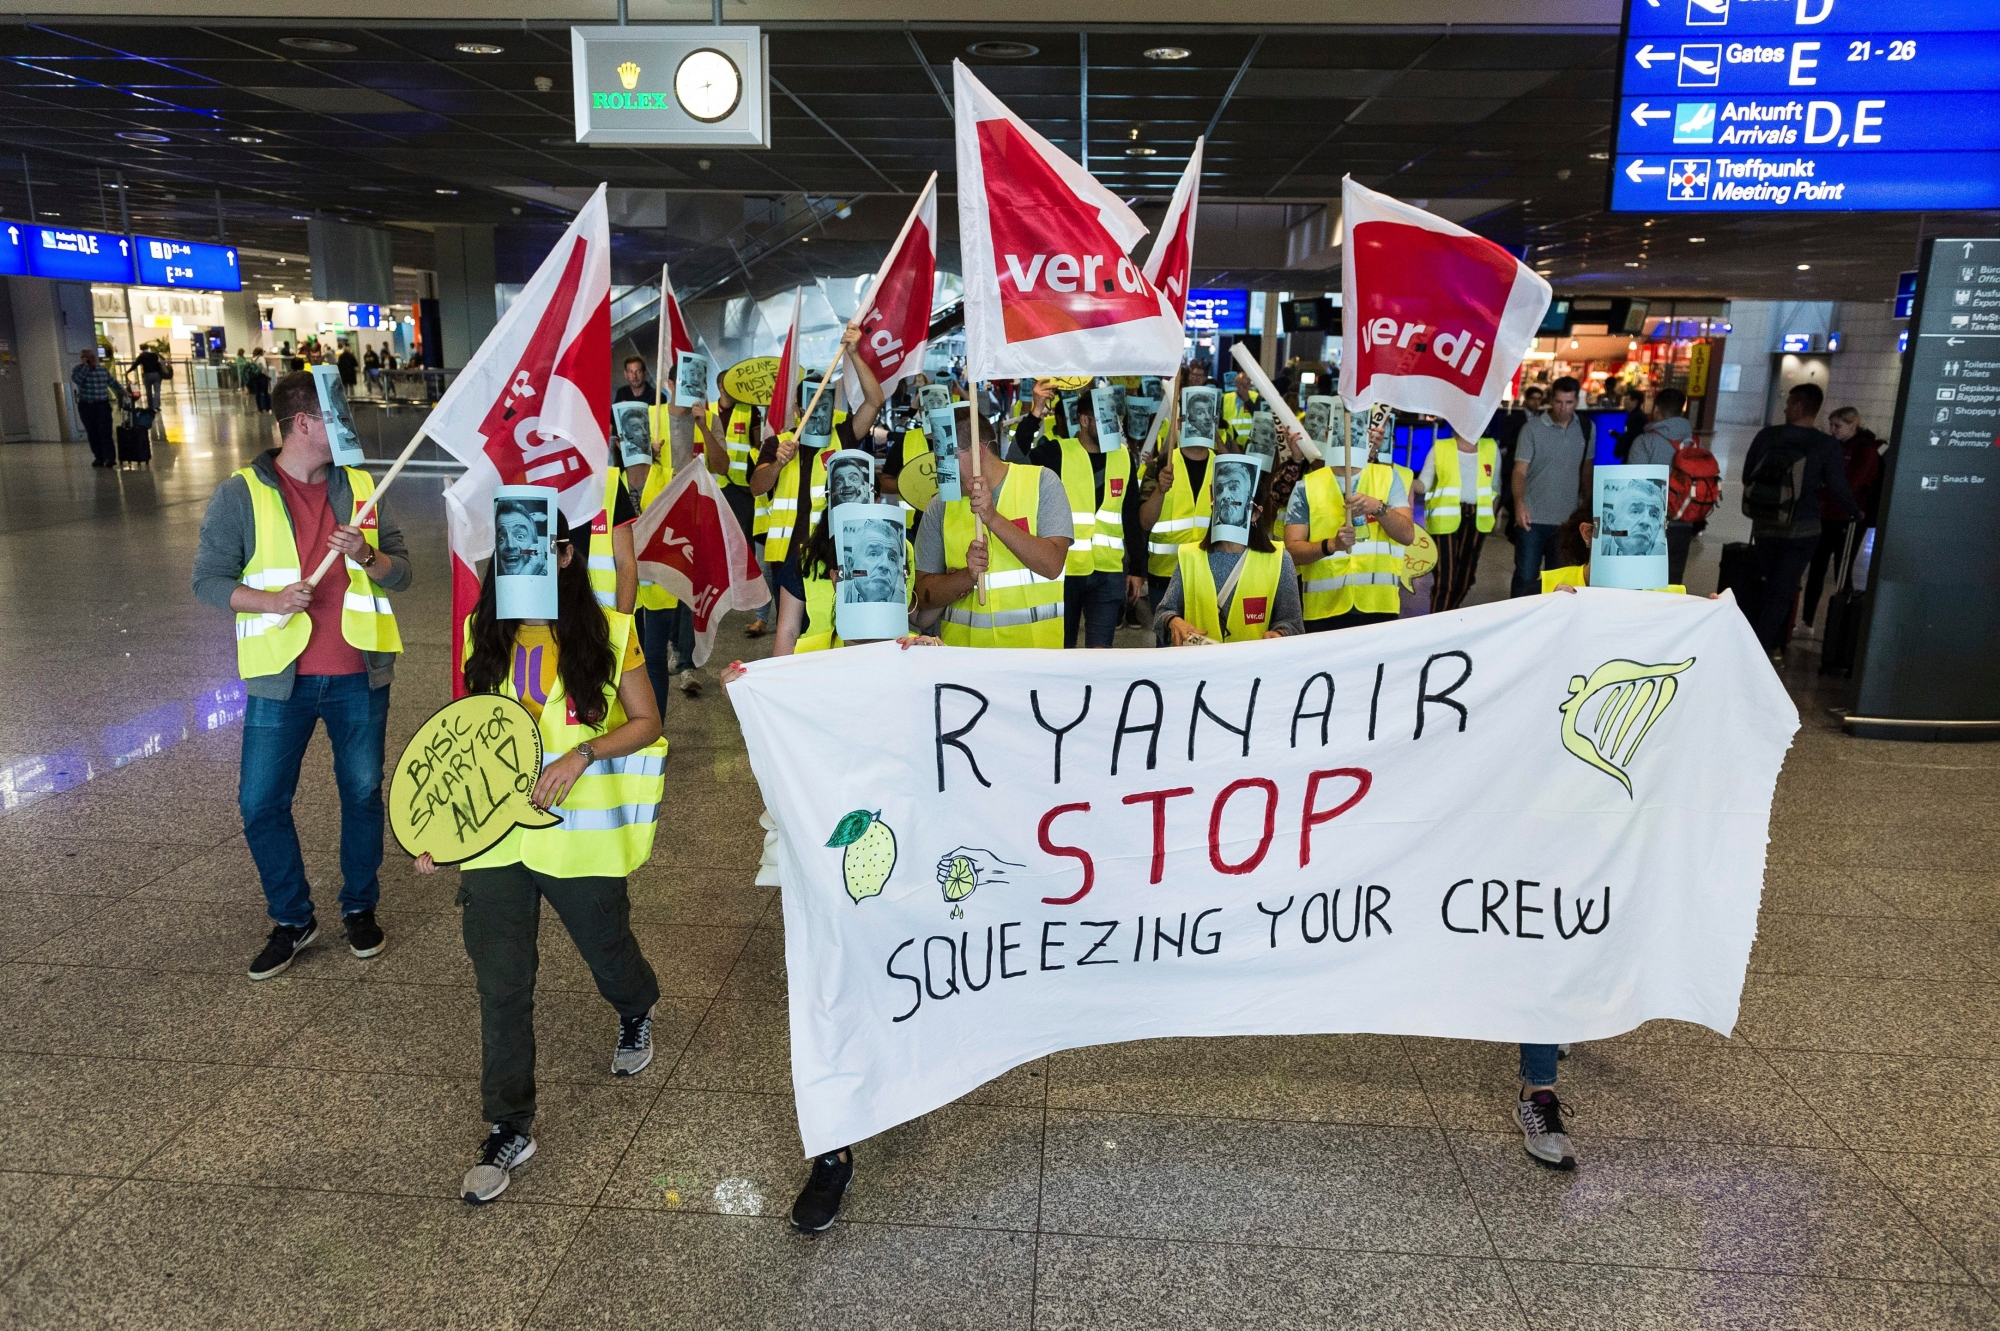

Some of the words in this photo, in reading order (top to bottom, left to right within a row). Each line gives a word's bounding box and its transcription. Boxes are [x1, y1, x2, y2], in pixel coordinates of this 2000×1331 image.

[1726, 43, 1785, 64] Gates
[1788, 42, 1821, 86] E
[1847, 41, 1871, 61] 21
[1887, 40, 1917, 61] 26
[592, 92, 668, 109] ROLEX
[1720, 101, 1803, 121] Ankunft
[1804, 100, 1886, 147] D,E
[1718, 125, 1797, 145] Arrivals
[1715, 158, 1815, 181] Treffpunkt
[1712, 182, 1791, 204] Meeting
[1793, 181, 1845, 200] Point
[1362, 317, 1486, 377] ver.di
[736, 361, 778, 379] DELAYS
[1962, 369, 1990, 378] Toilets
[735, 374, 767, 394] MUST
[1956, 392, 1995, 403] Baggage
[1370, 402, 1390, 428] ver
[1955, 406, 1996, 417] Shopping
[1948, 439, 1992, 448] Pharmacy
[1950, 430, 1992, 439] Apotheke
[1942, 475, 1969, 483] Snack
[1971, 476, 1985, 484] Bar
[363, 518, 376, 526] r.di
[935, 650, 1473, 792] RYANAIR
[411, 738, 478, 839] SALARY
[475, 706, 513, 749] FOR
[1038, 767, 1373, 905] STOP
[888, 908, 1222, 1022] SQUEEZING
[1257, 885, 1393, 949] YOUR
[1441, 878, 1611, 941] CREW
